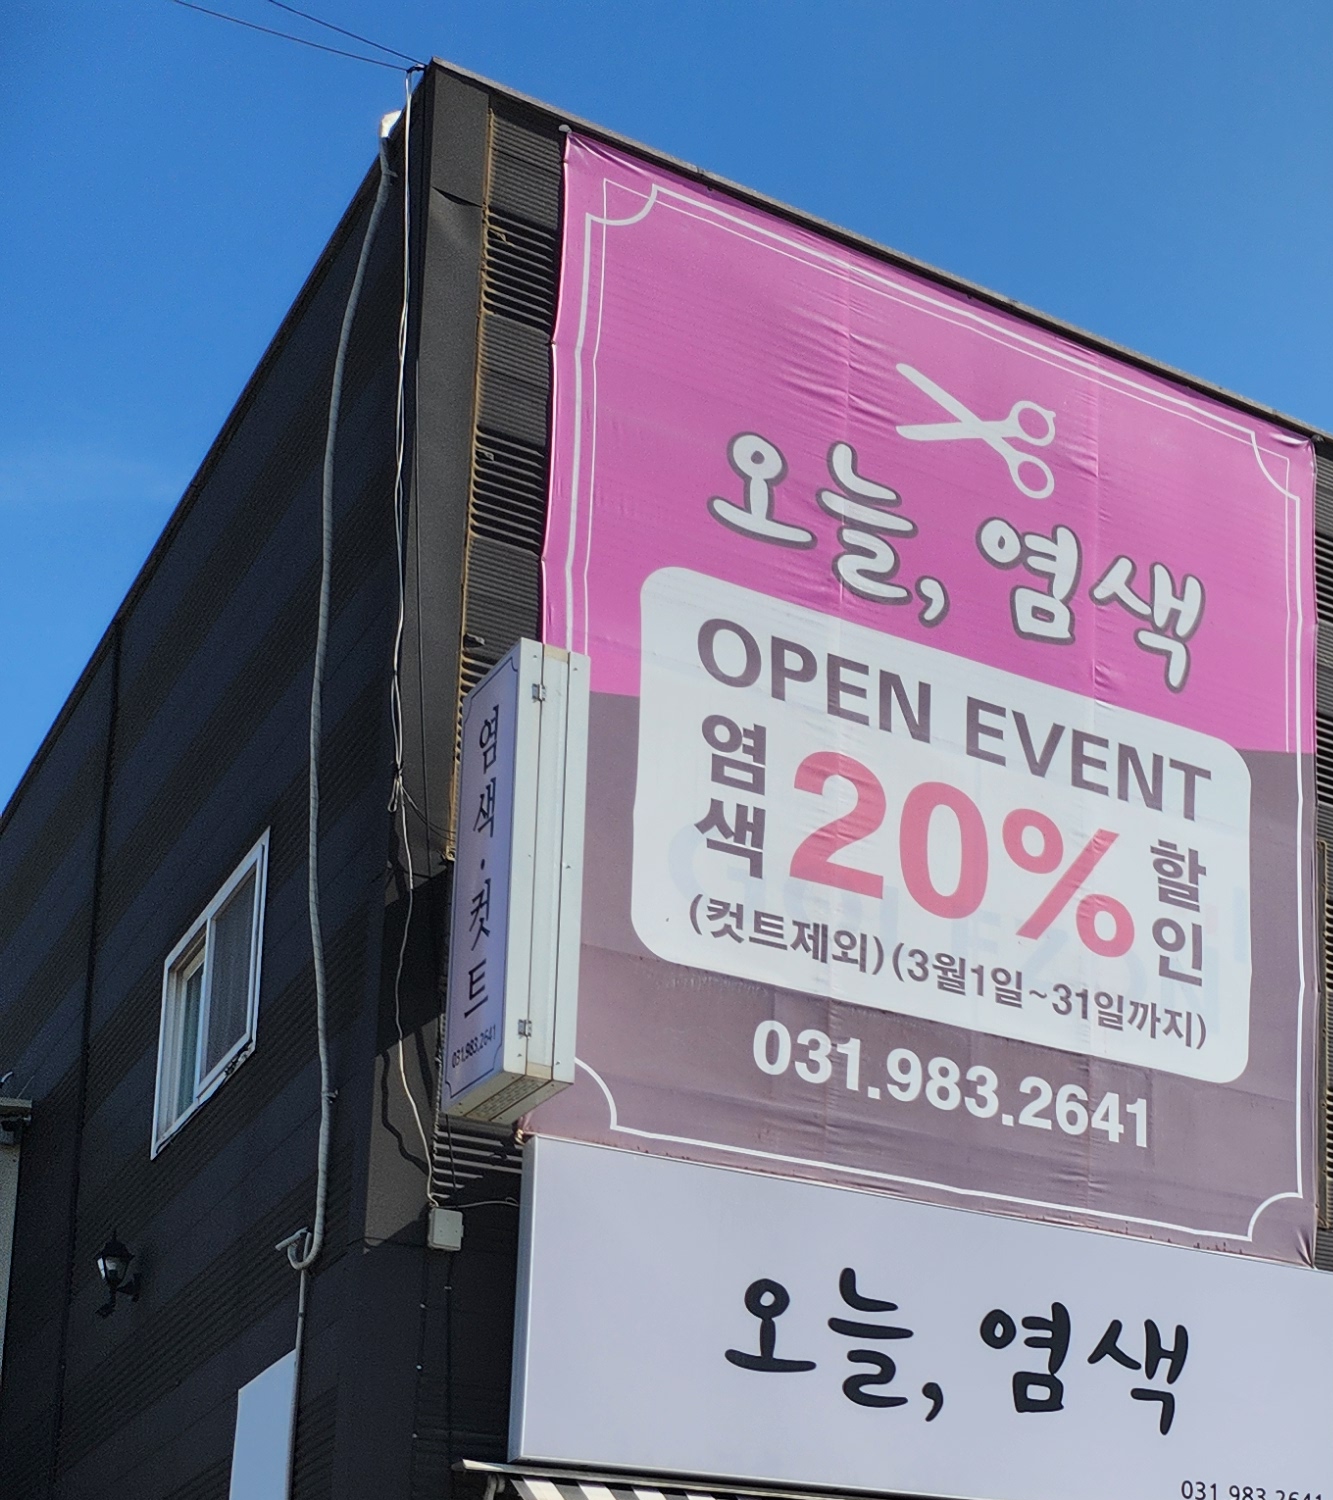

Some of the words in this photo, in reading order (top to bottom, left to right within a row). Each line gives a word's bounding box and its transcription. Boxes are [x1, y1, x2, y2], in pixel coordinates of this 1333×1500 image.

[707, 430, 949, 626] 오늘,
[975, 524, 1204, 692] 염색
[697, 617, 932, 743] OPEN
[964, 696, 1212, 821] EVENT
[789, 750, 1135, 958] 20%
[1149, 839, 1207, 987] 할인
[451, 1028, 497, 1070] 031.983.2641
[689, 894, 884, 976] (컷트제외)
[892, 942, 1207, 1049] (3월1일~31일까지)
[752, 1019, 1151, 1149] 031.983.2641
[725, 1267, 945, 1422] 오늘,
[979, 1301, 1190, 1436] 염색
